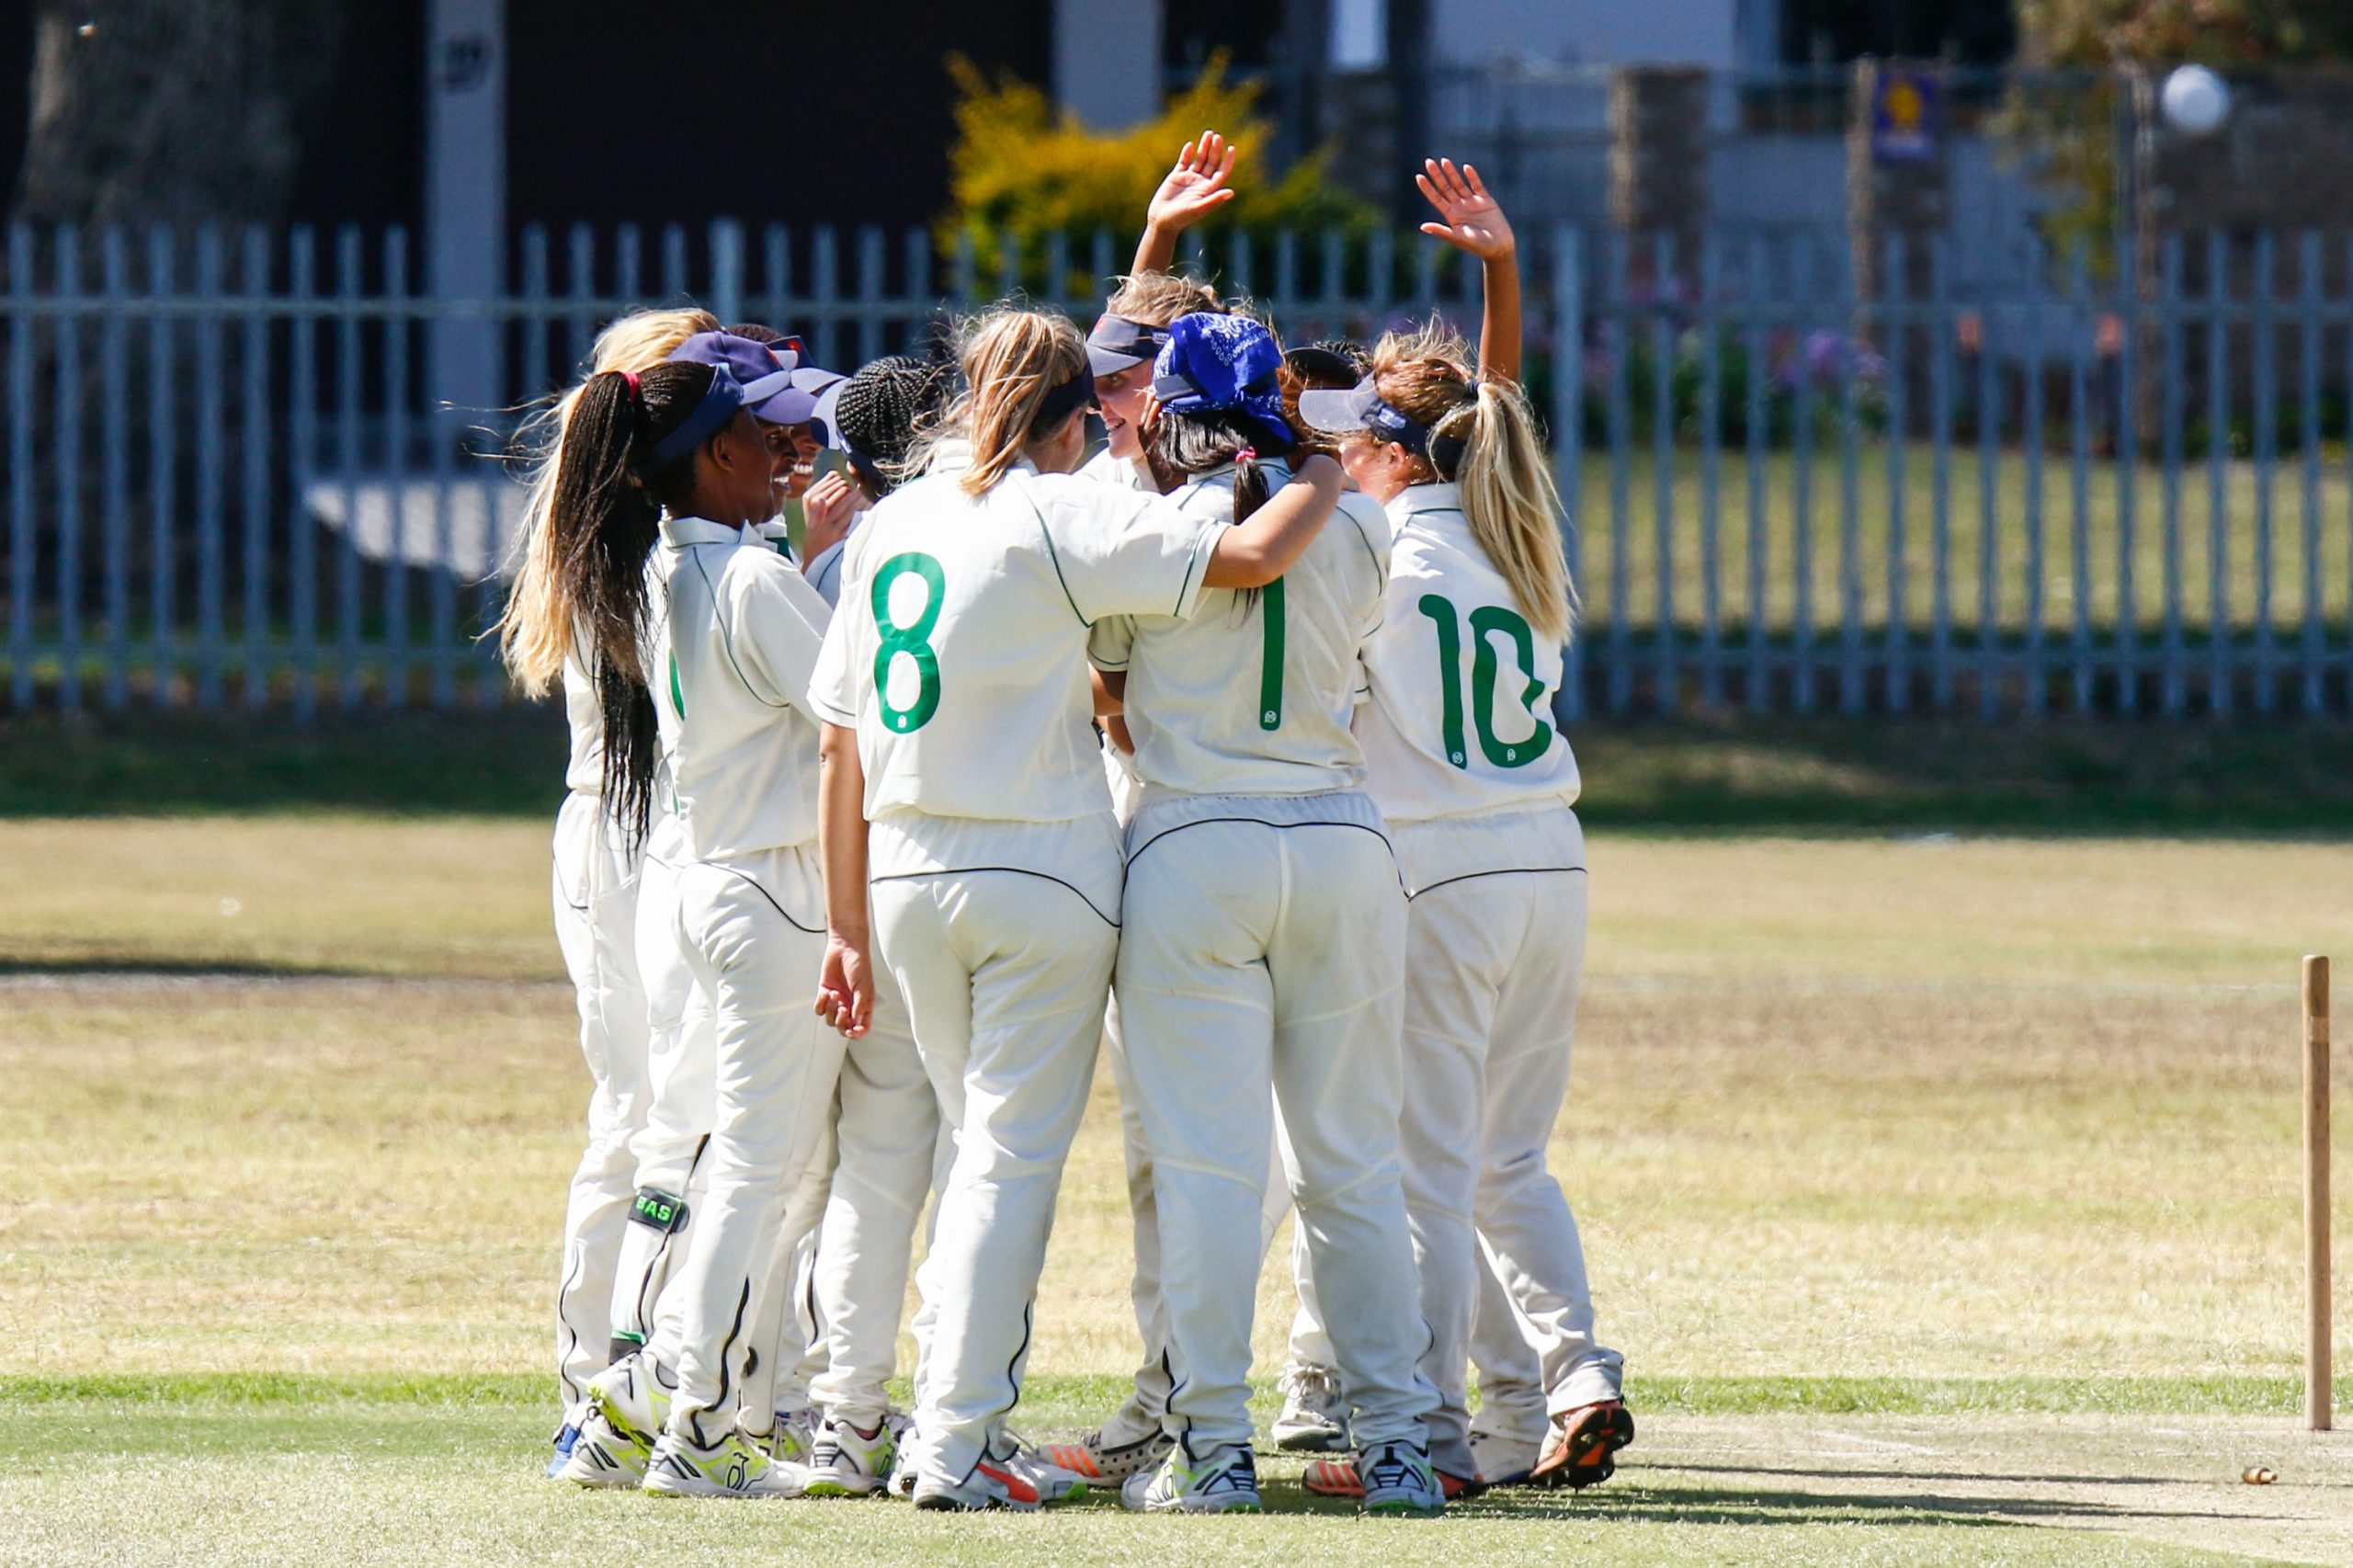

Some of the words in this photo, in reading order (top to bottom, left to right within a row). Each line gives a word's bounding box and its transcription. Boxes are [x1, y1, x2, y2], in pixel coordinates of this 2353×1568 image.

[870, 551, 945, 734] 8
[1418, 594, 1553, 769] 10
[636, 1196, 672, 1221] BAS
